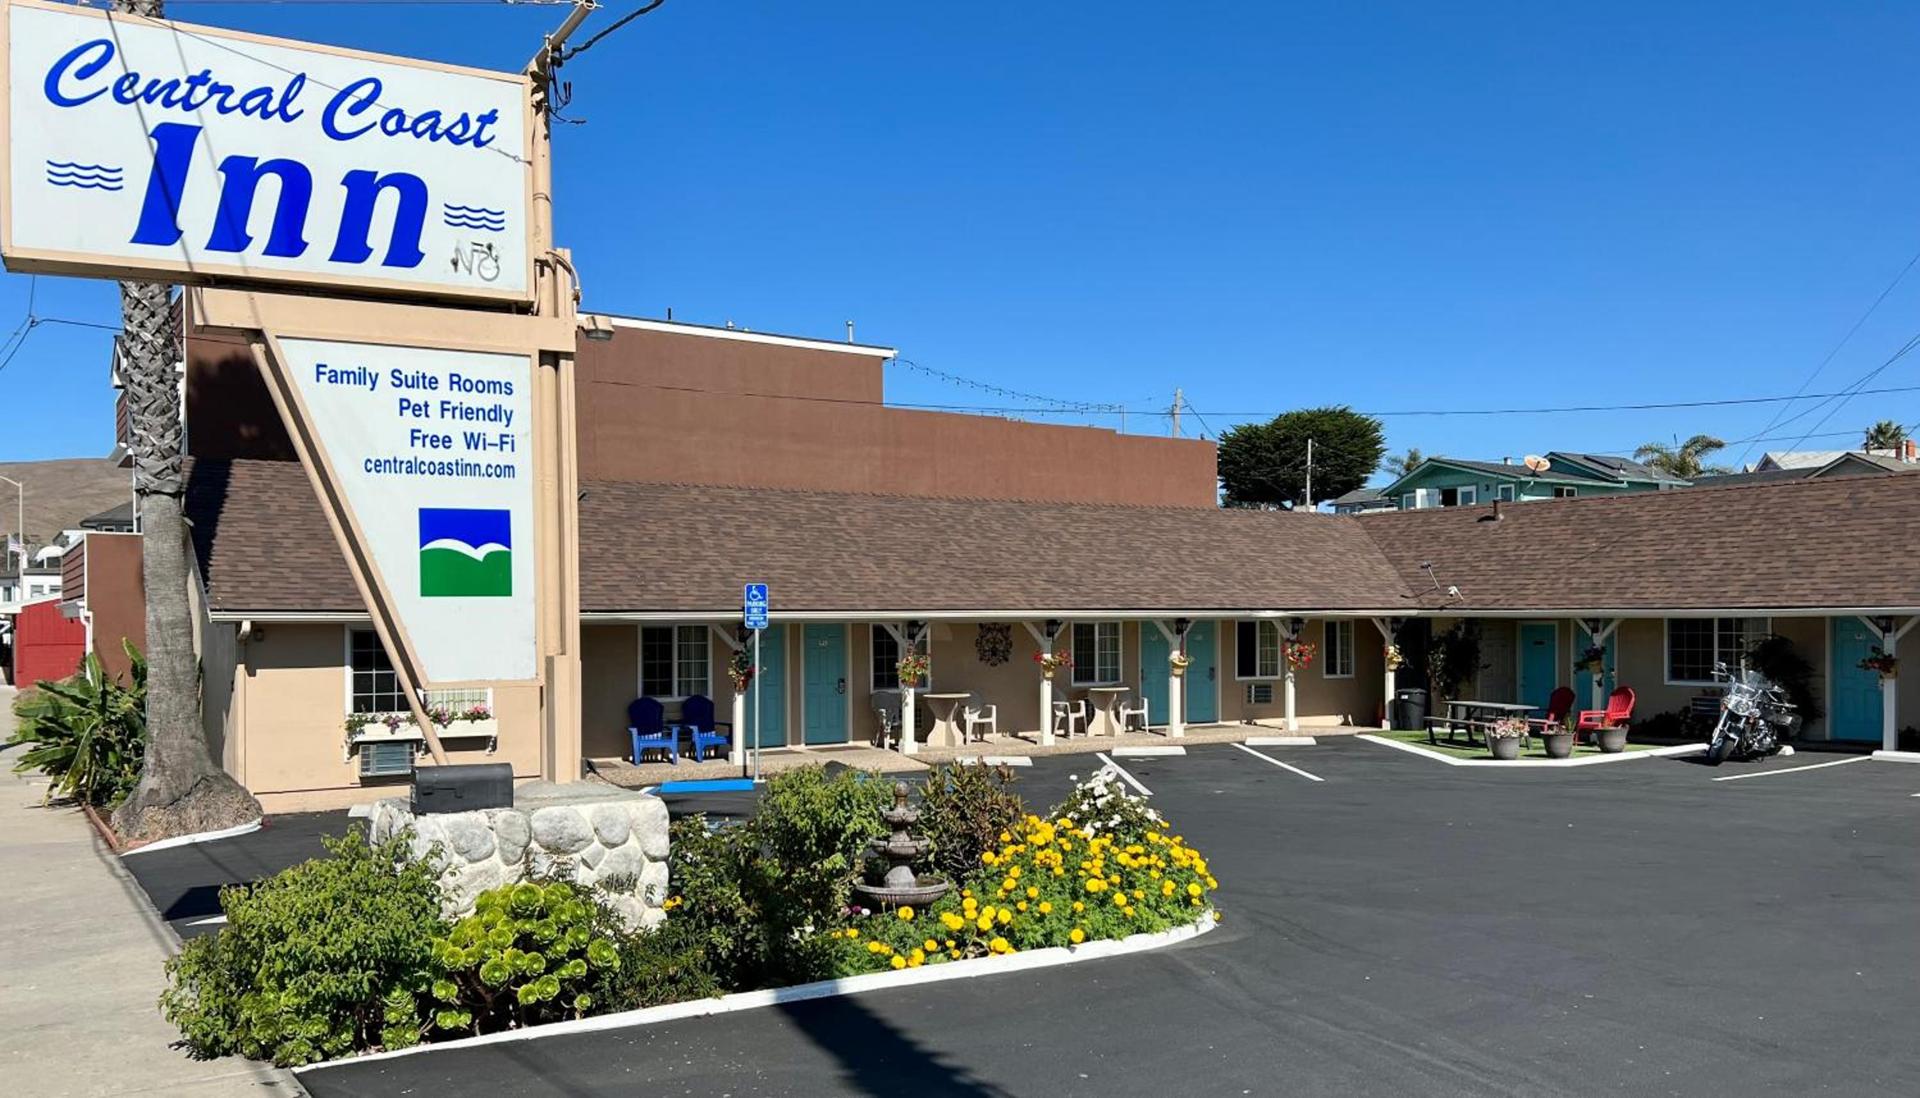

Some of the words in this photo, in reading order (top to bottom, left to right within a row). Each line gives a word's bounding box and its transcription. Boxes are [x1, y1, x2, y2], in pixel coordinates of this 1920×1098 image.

[44, 39, 306, 122] Central
[321, 77, 498, 148] Coast
[130, 122, 429, 268] Inn
[315, 363, 379, 391] Family
[390, 369, 439, 390] Suite
[448, 374, 513, 395] Rooms
[399, 398, 430, 418] Pet
[440, 401, 513, 427] Friendly
[410, 430, 452, 448] Free
[464, 432, 515, 452] Wi-Fi
[364, 457, 515, 478] centralcoastinn.com
